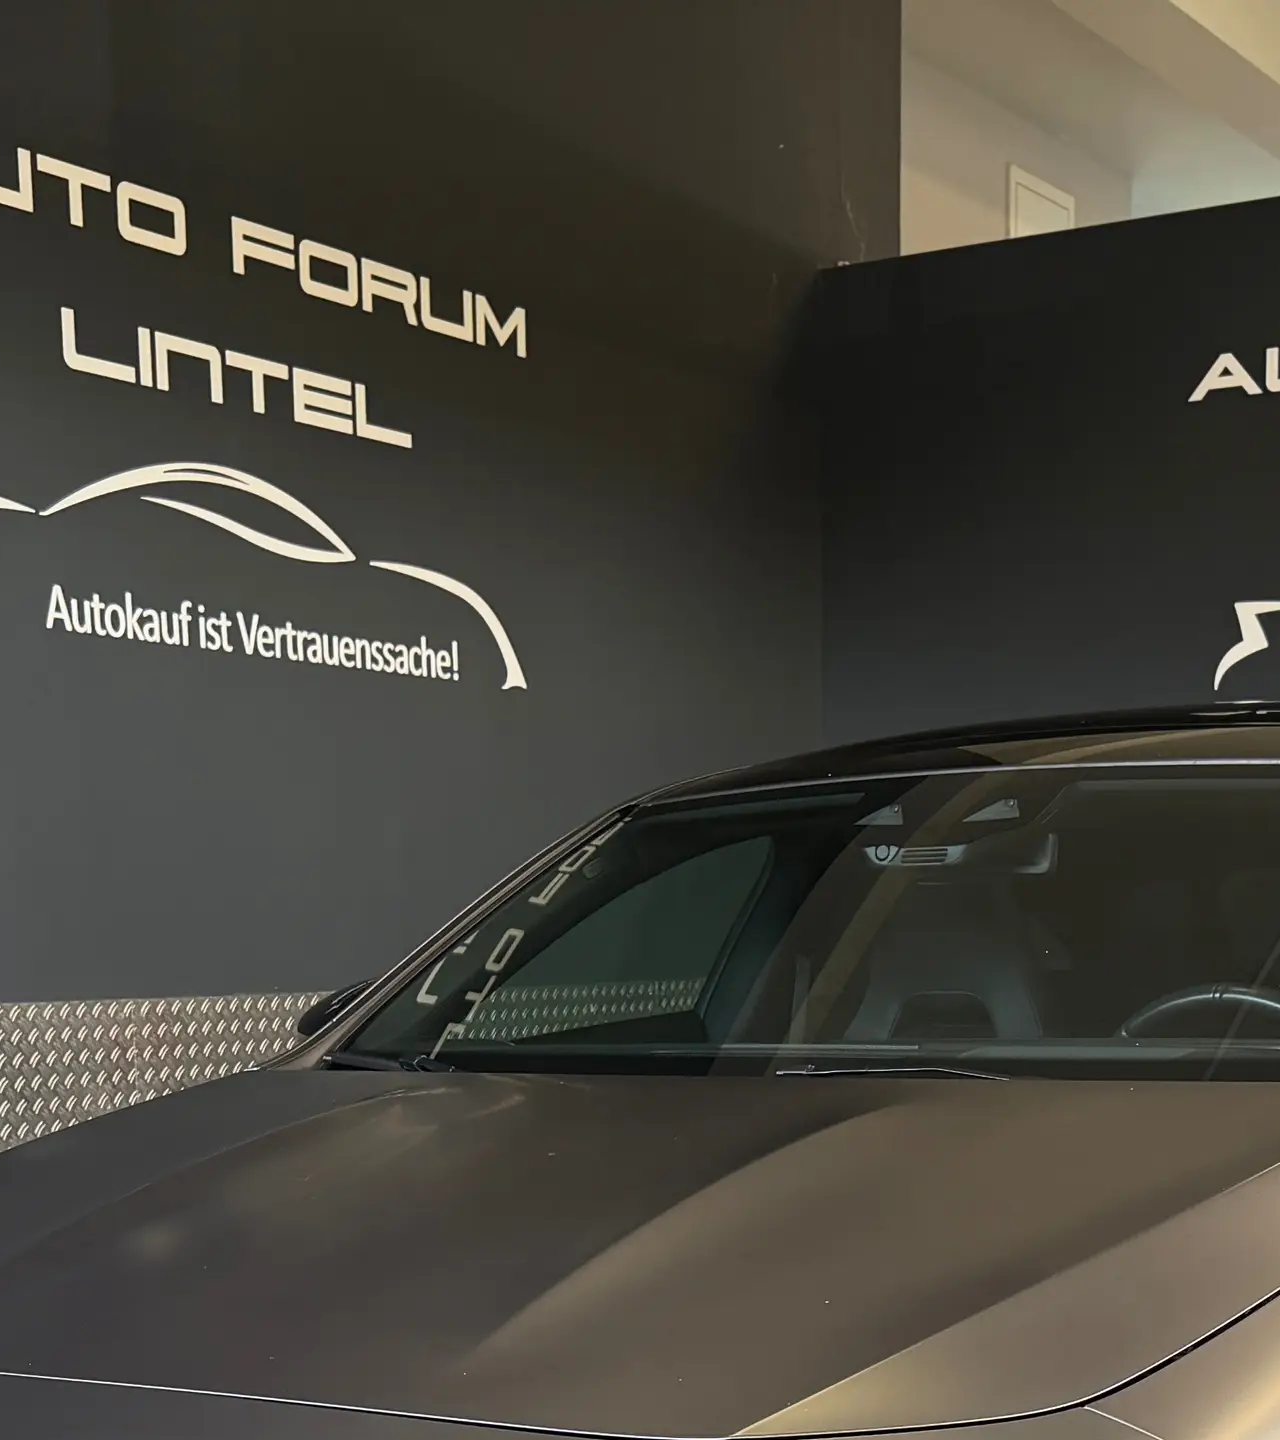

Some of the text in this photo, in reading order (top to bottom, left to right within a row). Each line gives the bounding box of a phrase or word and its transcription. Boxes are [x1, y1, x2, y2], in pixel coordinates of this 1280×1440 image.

[231, 216, 527, 358] FORUM
[61, 307, 413, 448] LINTEL
[46, 584, 460, 682] Autokauf ist Vertrauenssache!
